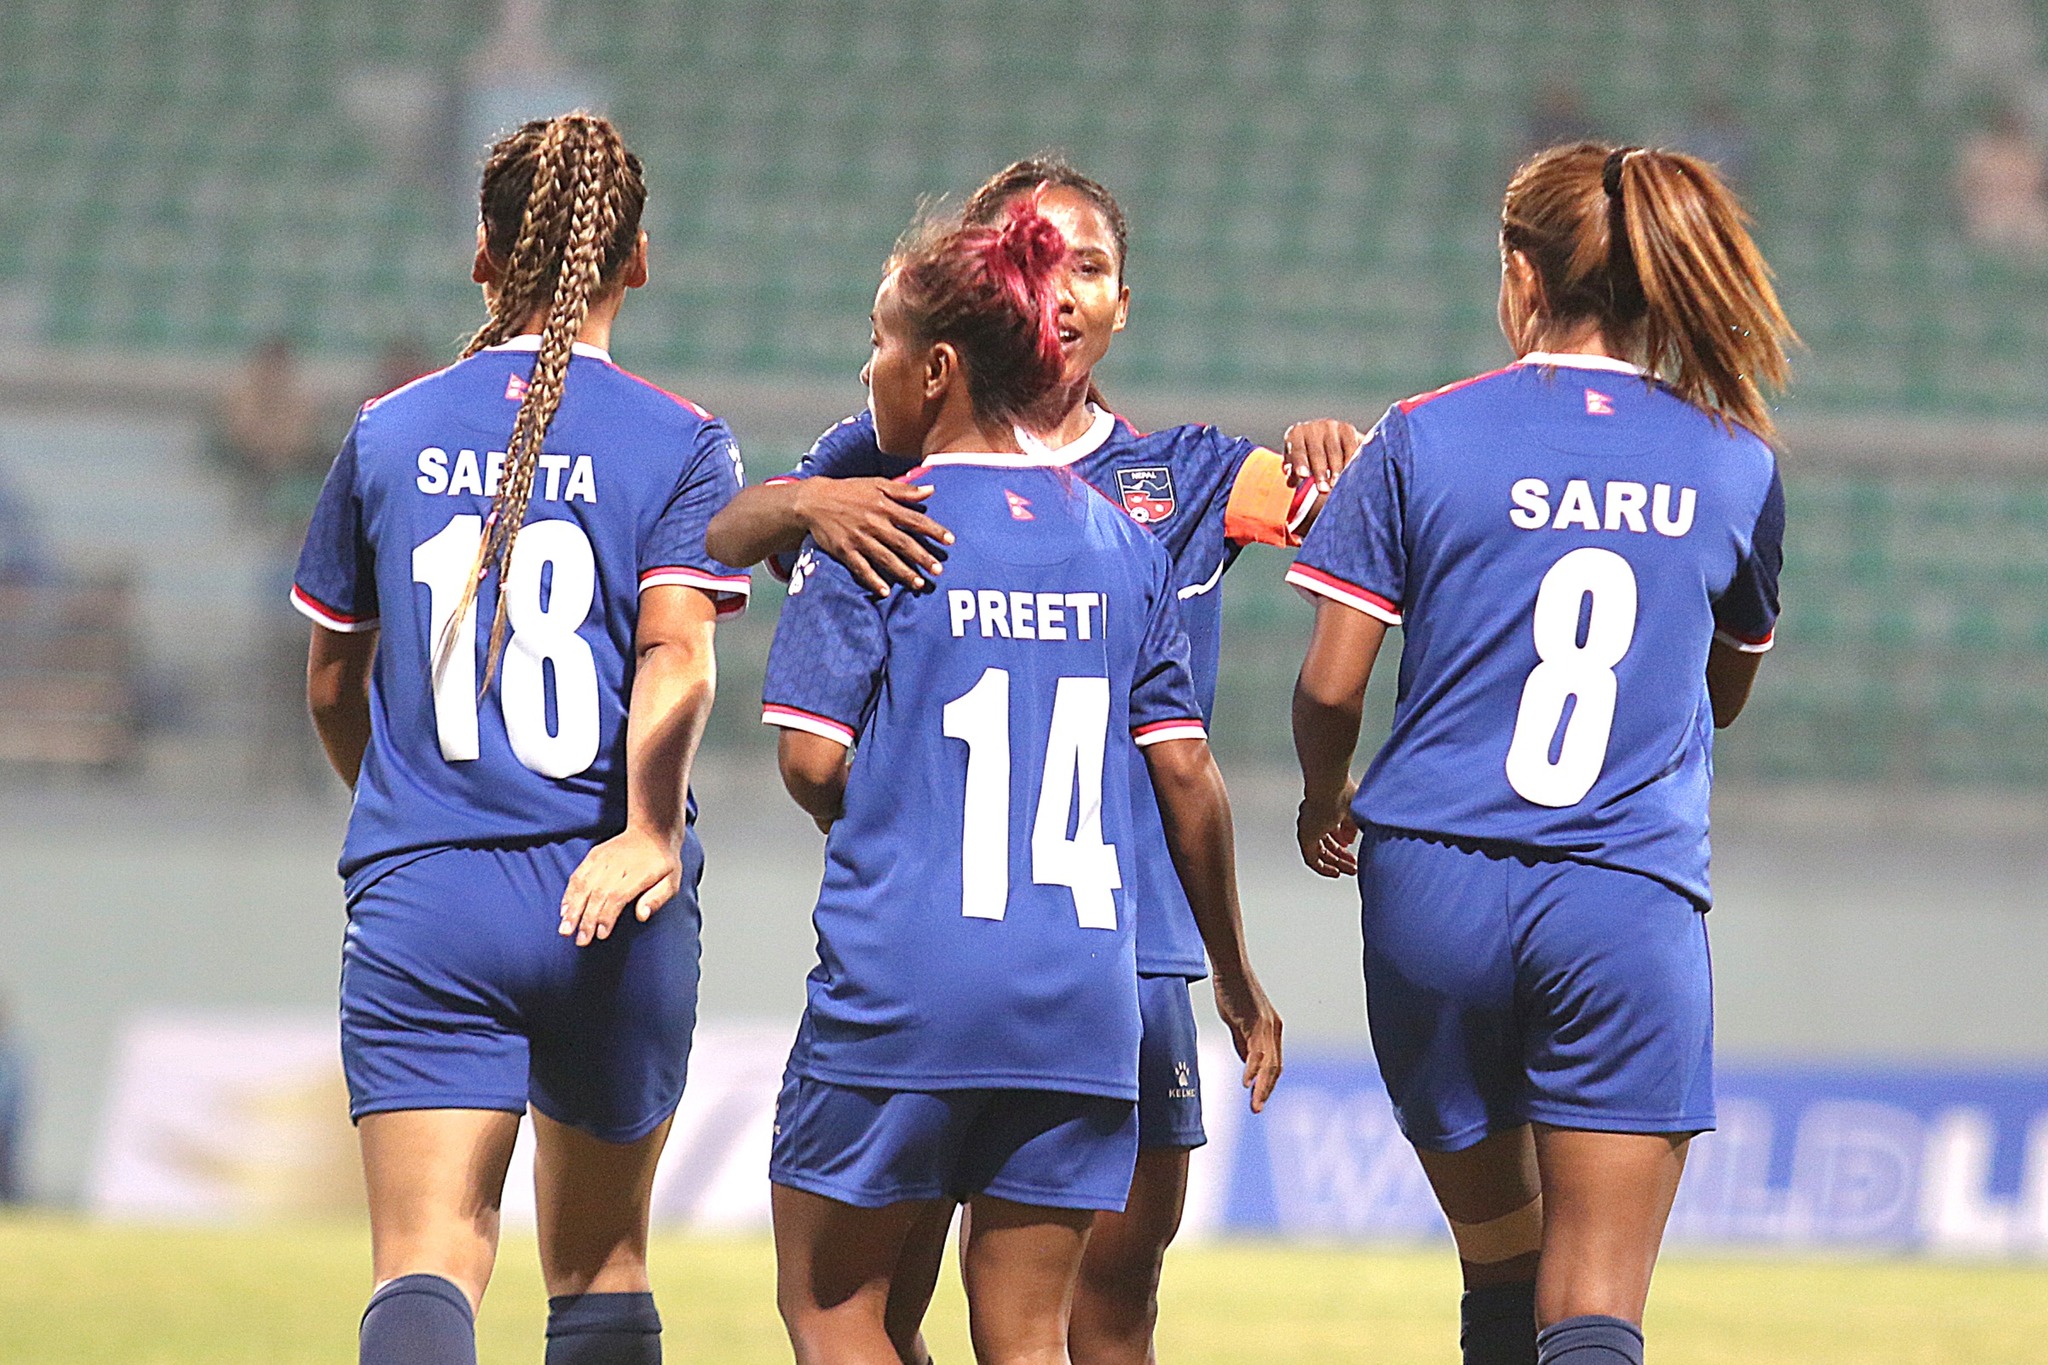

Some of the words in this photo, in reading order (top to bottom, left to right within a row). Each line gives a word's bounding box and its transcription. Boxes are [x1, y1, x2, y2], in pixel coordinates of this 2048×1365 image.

[1131, 471, 1157, 480] NEPAL
[1509, 477, 1697, 537] SARU
[411, 514, 600, 779] 18
[1505, 547, 1637, 808] 8
[942, 666, 1122, 930] 14
